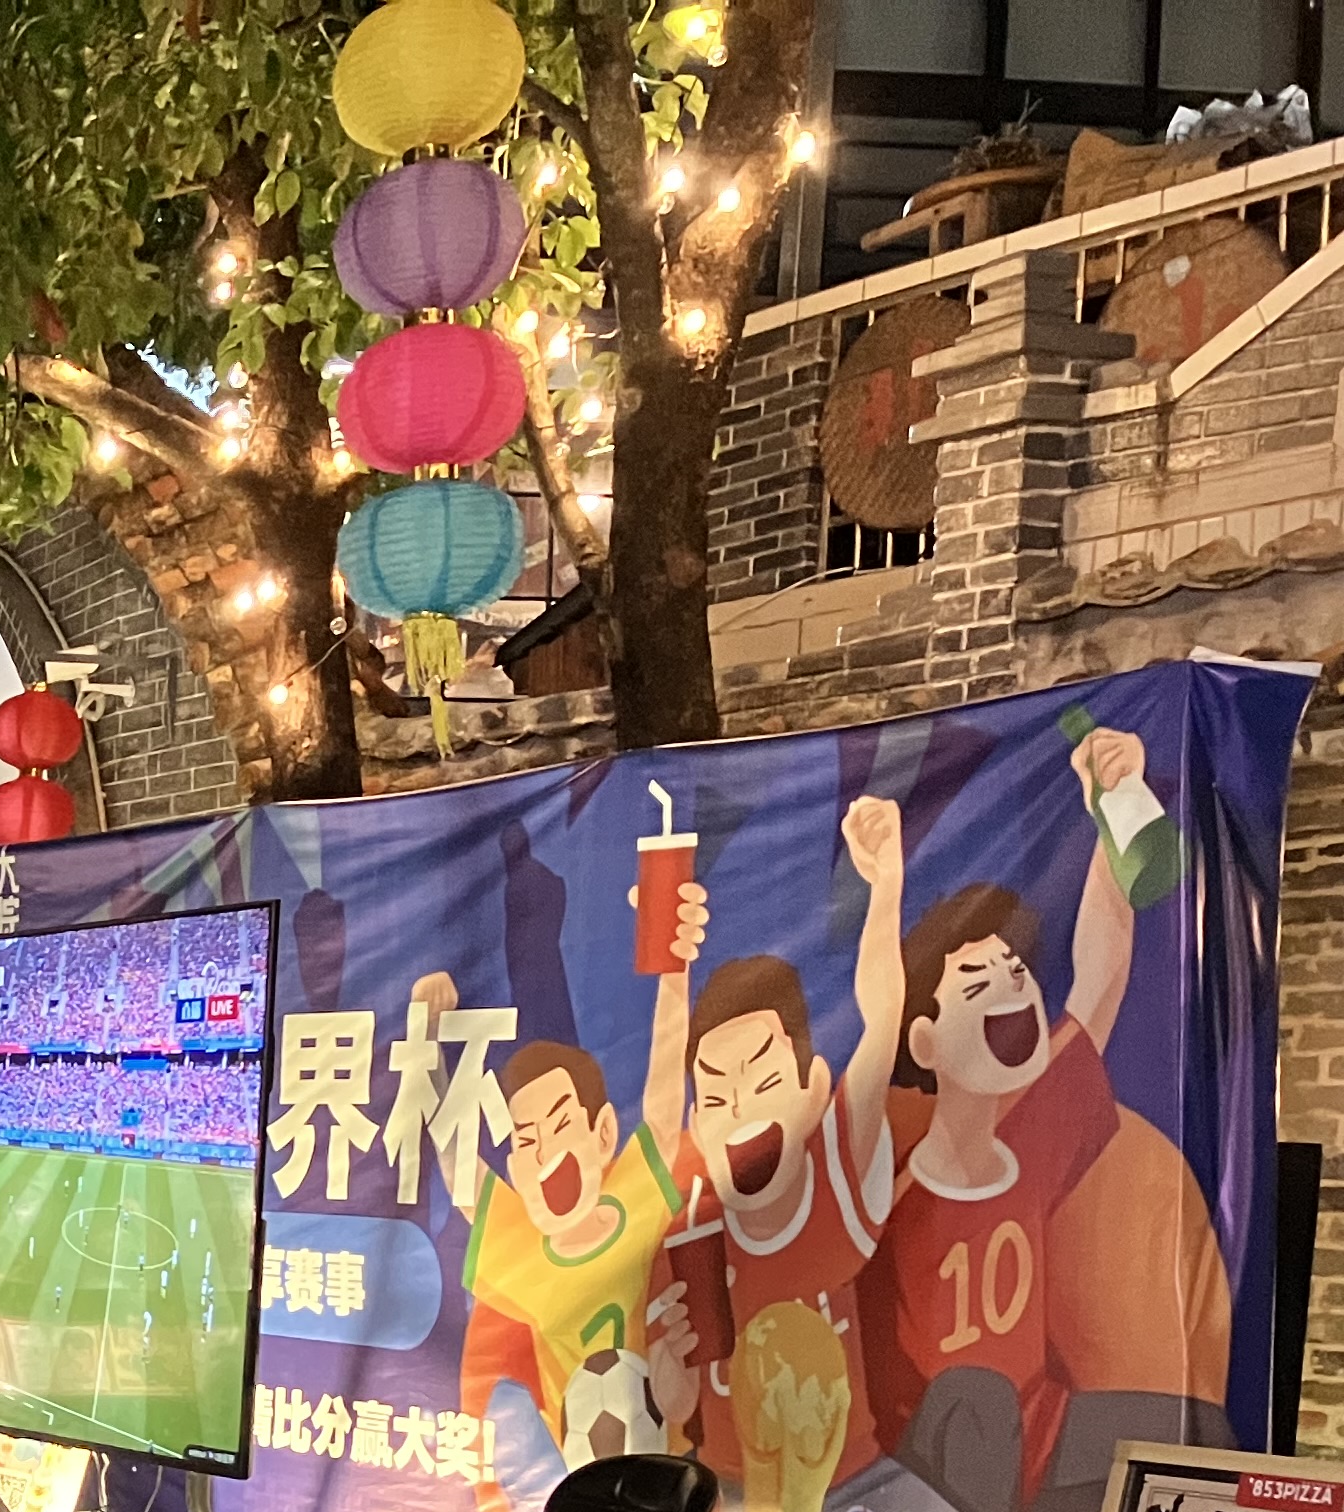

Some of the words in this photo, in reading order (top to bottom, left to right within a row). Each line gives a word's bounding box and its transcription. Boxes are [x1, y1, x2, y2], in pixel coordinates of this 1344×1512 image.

[210, 999, 235, 1017] LIVE
[266, 1001, 518, 1207] 界杯
[938, 1220, 1034, 1354] 10
